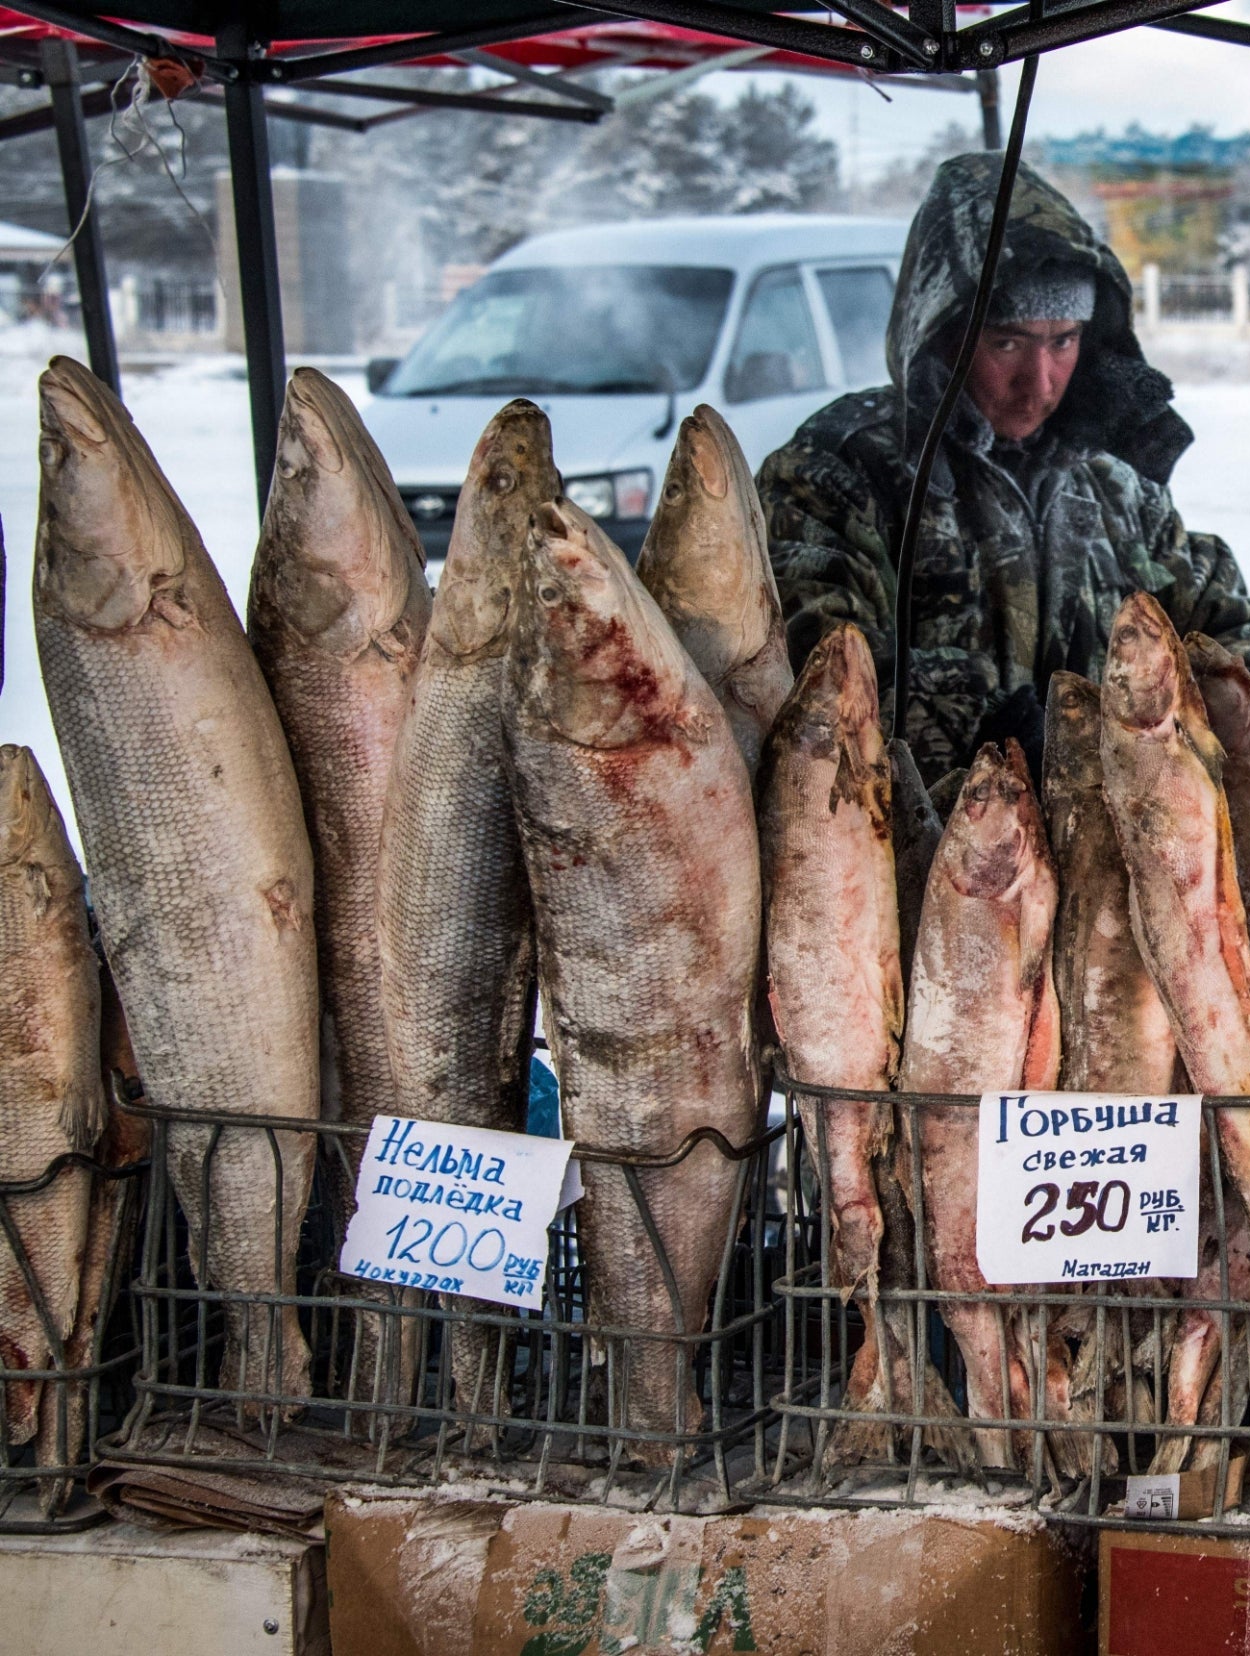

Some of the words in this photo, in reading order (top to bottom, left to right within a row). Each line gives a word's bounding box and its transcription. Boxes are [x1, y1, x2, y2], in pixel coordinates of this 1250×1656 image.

[996, 1095, 1179, 1143] Горбуша
[374, 1119, 506, 1185] Нельма
[1022, 1143, 1148, 1172] свежая
[372, 1175, 524, 1222] подлёдка
[1021, 1180, 1131, 1244] 250
[386, 1214, 506, 1272] 1200
[1061, 1259, 1151, 1278] Магадан
